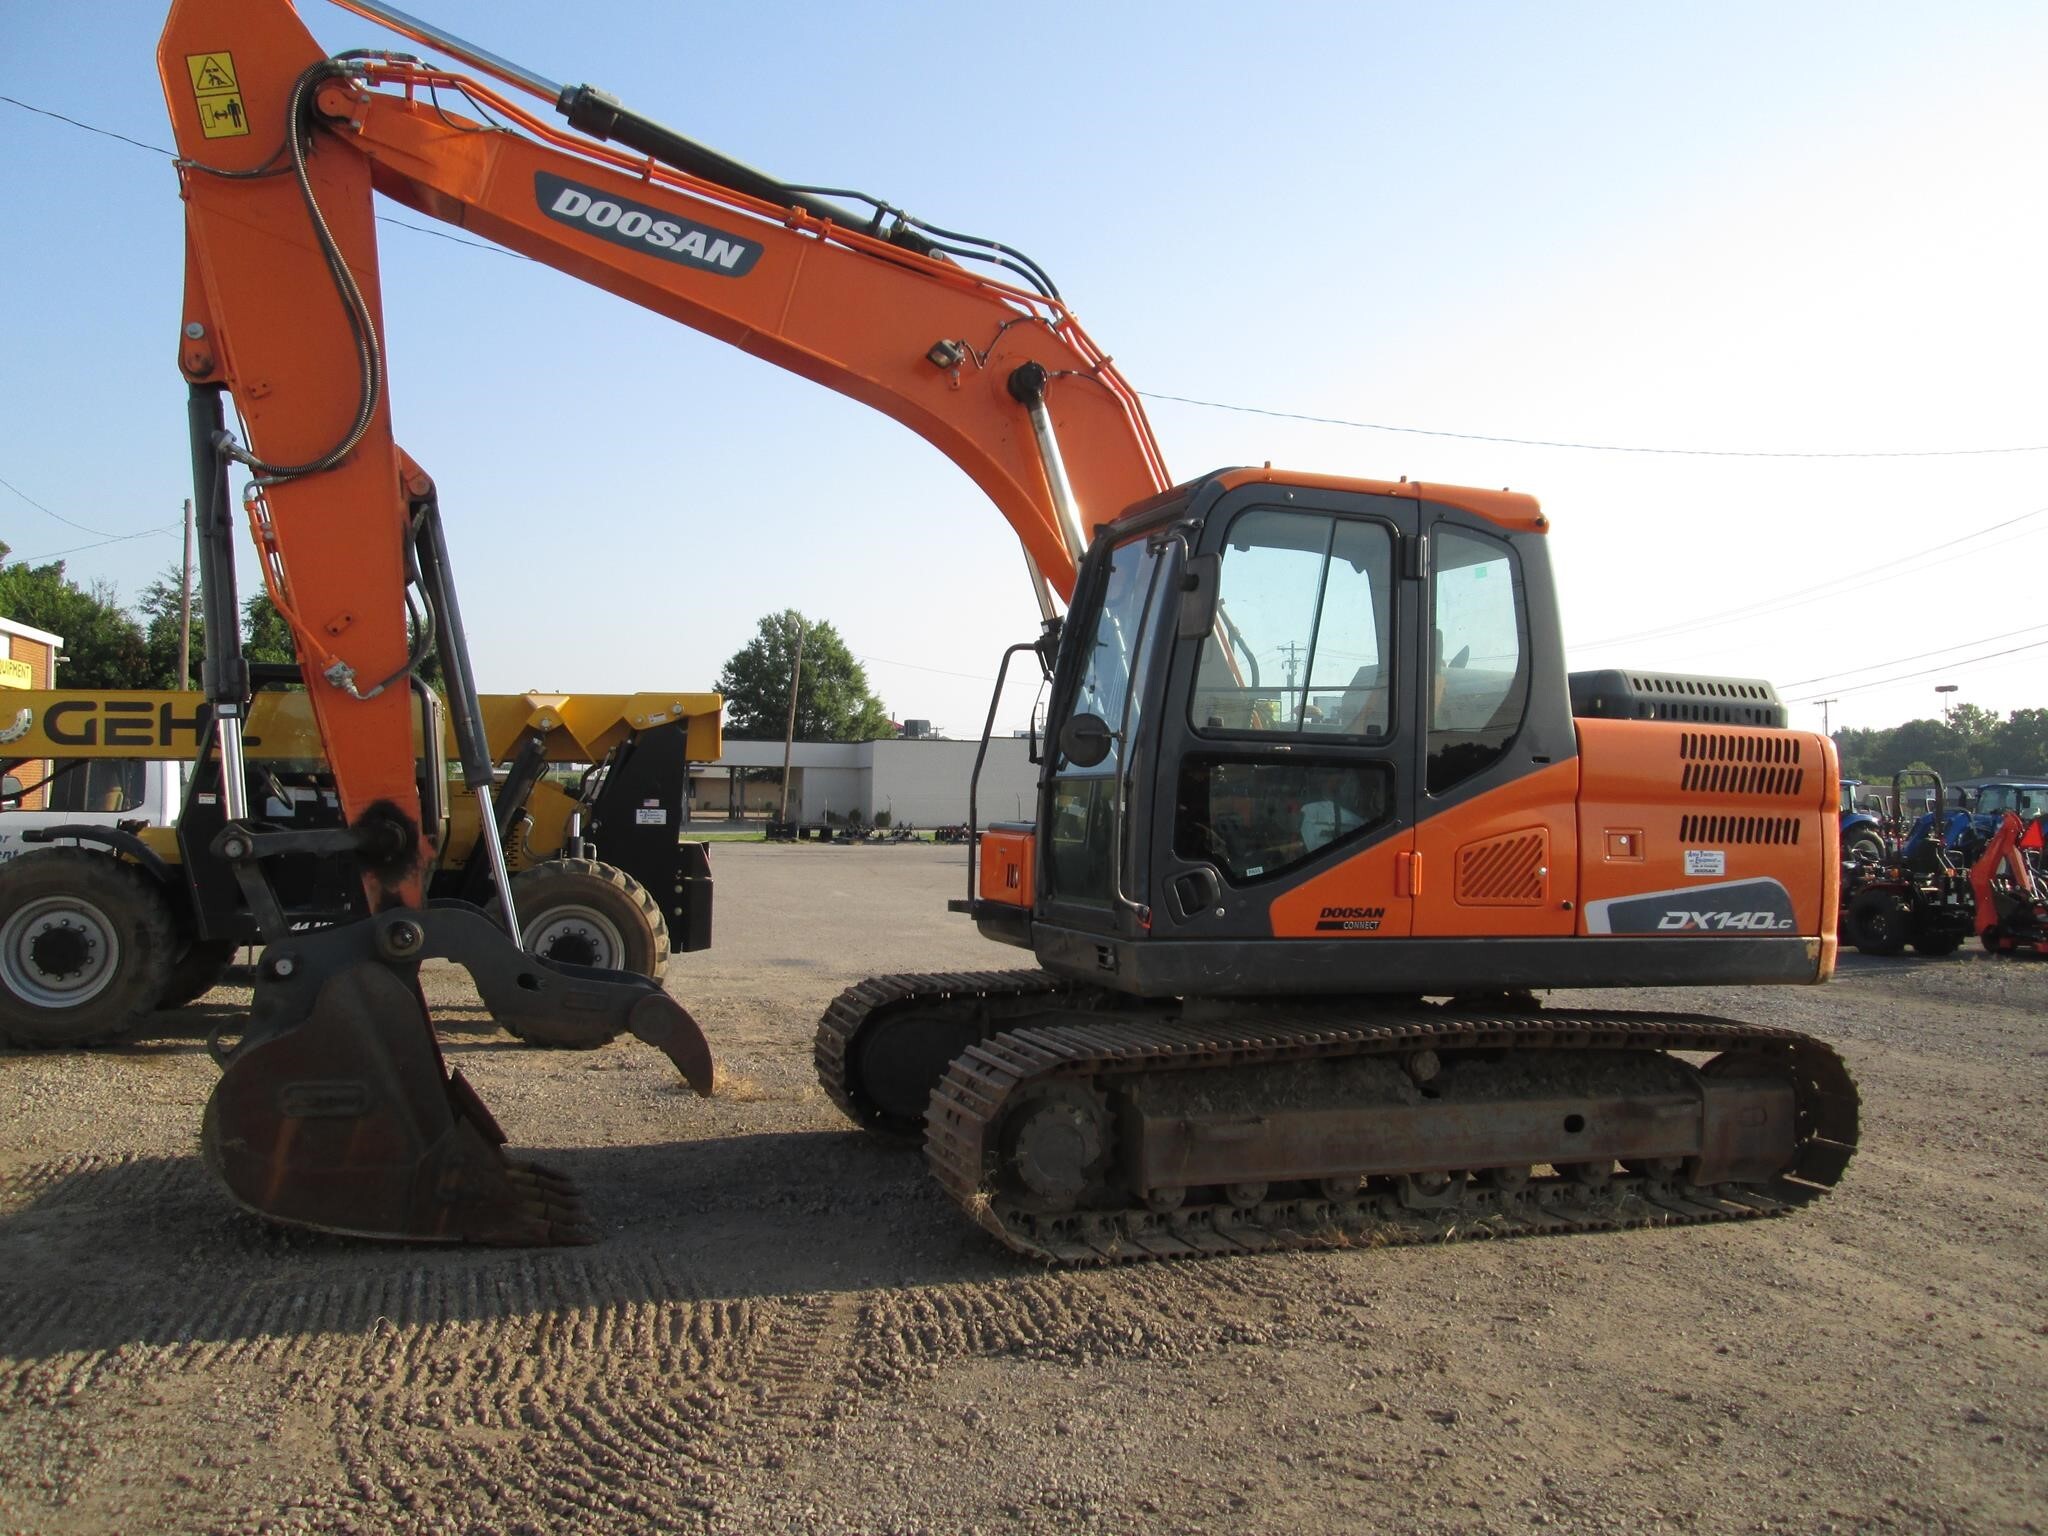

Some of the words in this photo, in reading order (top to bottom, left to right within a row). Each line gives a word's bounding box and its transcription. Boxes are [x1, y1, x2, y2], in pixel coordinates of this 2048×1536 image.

[552, 188, 745, 269] DOOSAN
[43, 701, 261, 746] GEH
[1320, 907, 1385, 918] DOOSAN
[1343, 921, 1379, 930] CONNECT
